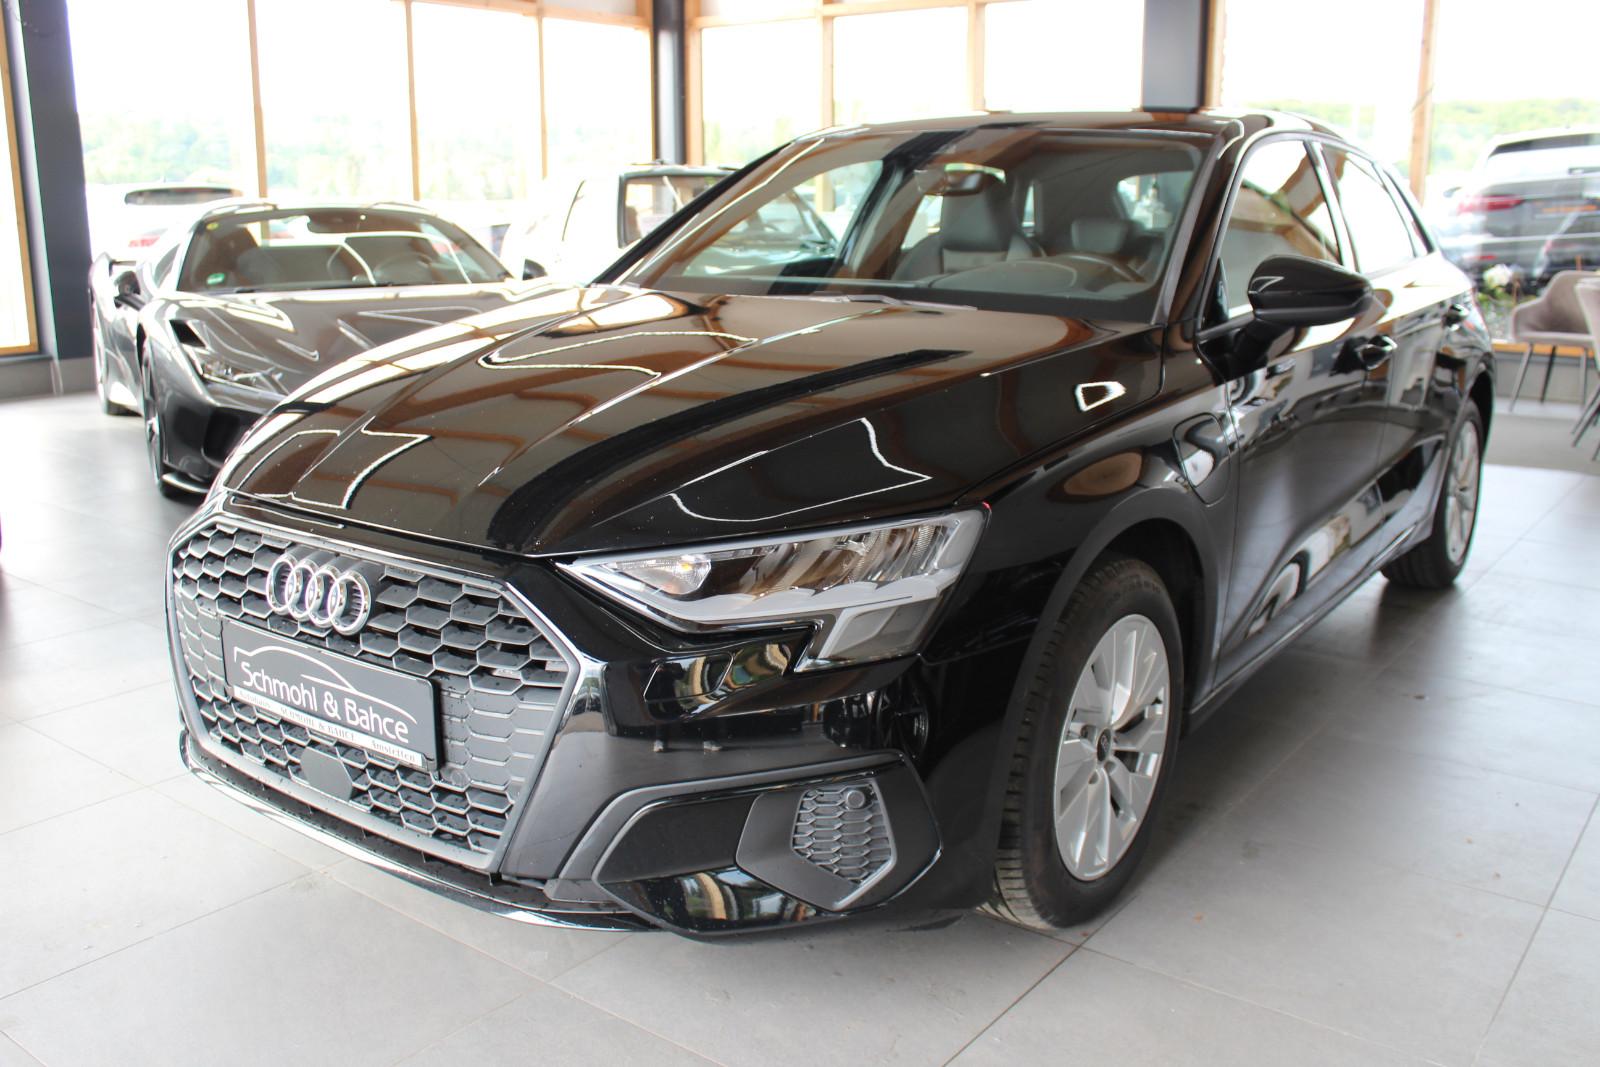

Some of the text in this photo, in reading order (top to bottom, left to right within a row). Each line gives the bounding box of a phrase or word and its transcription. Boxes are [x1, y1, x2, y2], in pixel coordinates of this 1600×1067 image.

[241, 661, 409, 743] Schmohl & Bahce
